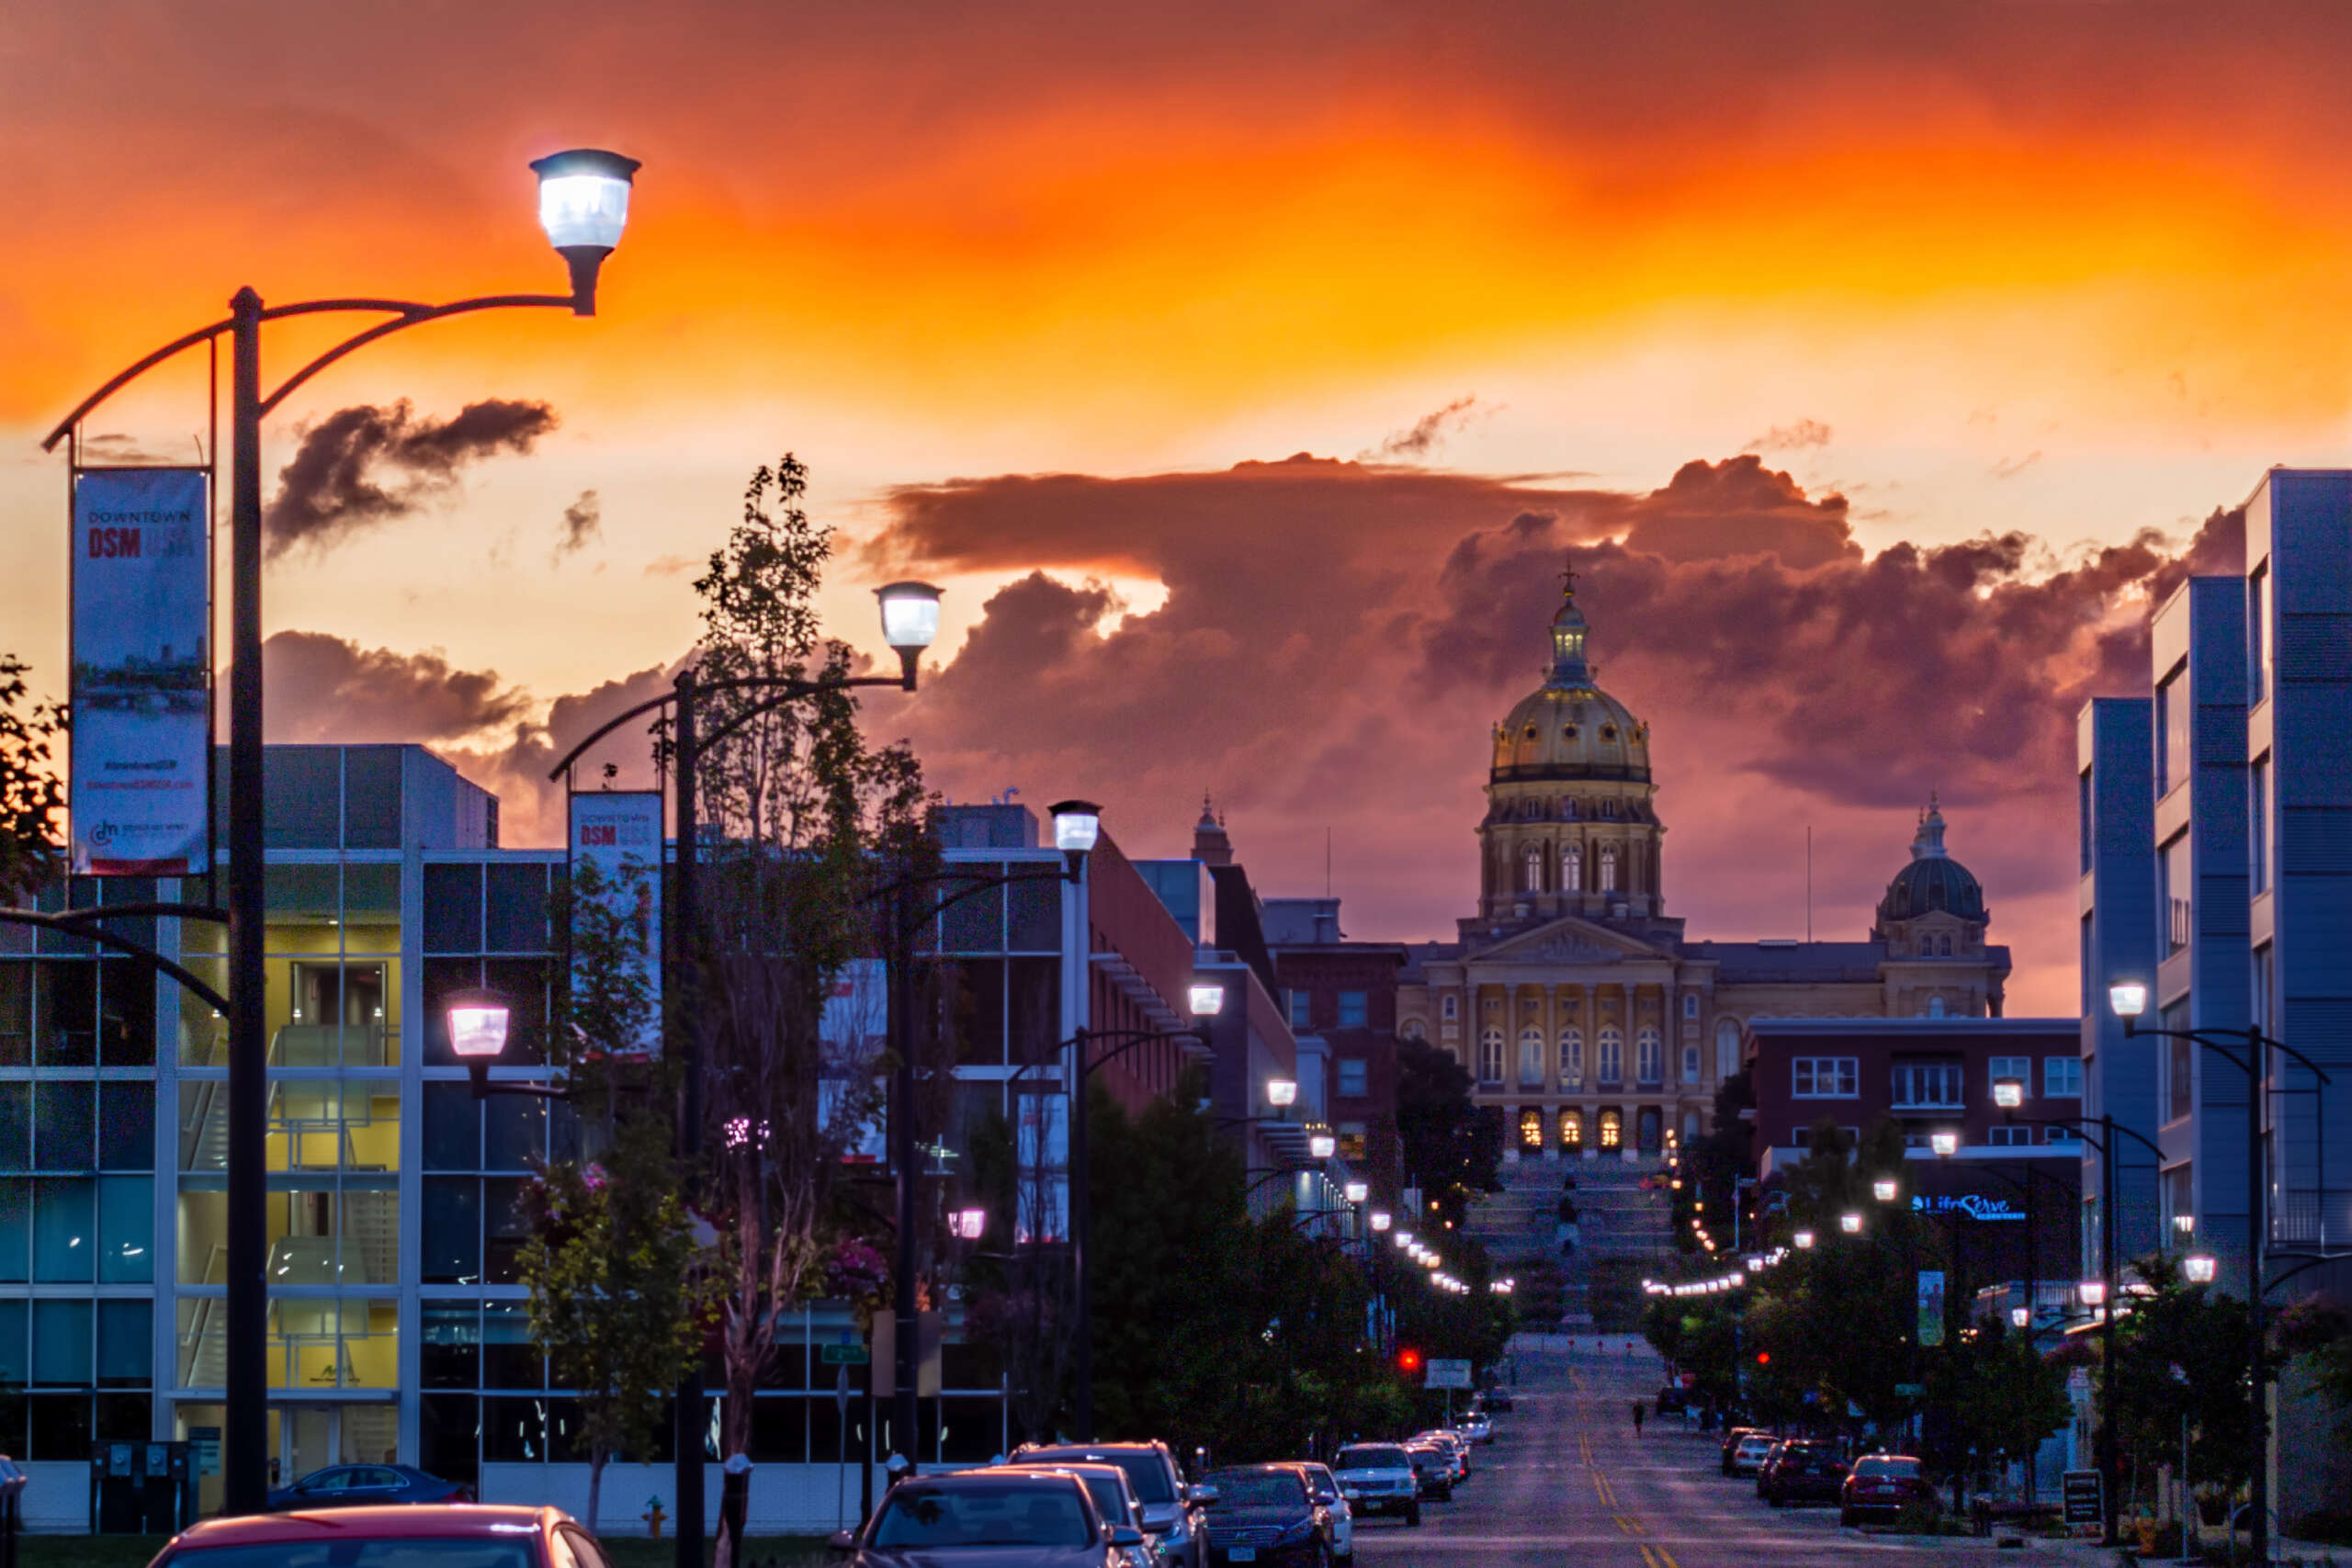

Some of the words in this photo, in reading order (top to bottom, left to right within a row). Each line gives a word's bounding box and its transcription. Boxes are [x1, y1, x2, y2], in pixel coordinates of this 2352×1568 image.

[88, 512, 190, 524] DOWNTOWN
[88, 526, 141, 558] DSM
[582, 825, 616, 845] DSM
